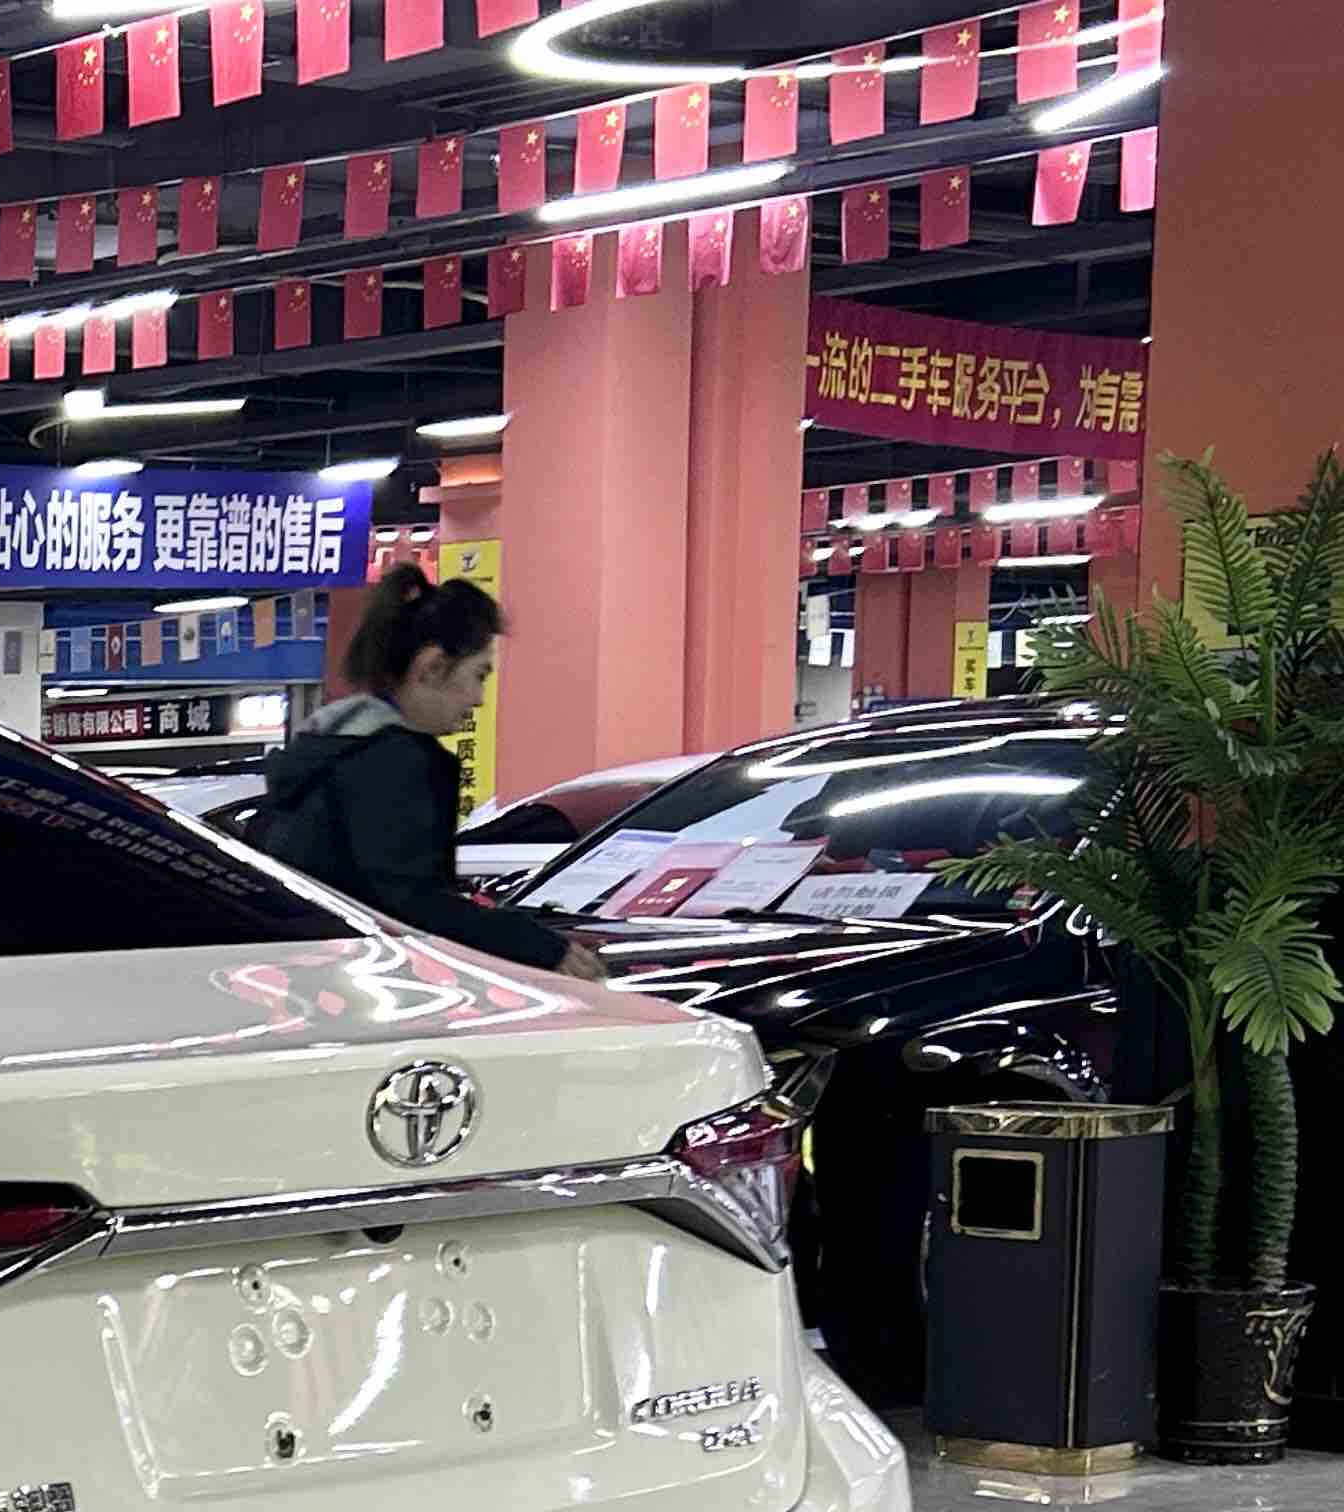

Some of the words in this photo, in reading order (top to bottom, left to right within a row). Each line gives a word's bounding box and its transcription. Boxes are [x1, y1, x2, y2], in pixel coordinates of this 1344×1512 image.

[154, 492, 345, 573] 更靠谱的售后
